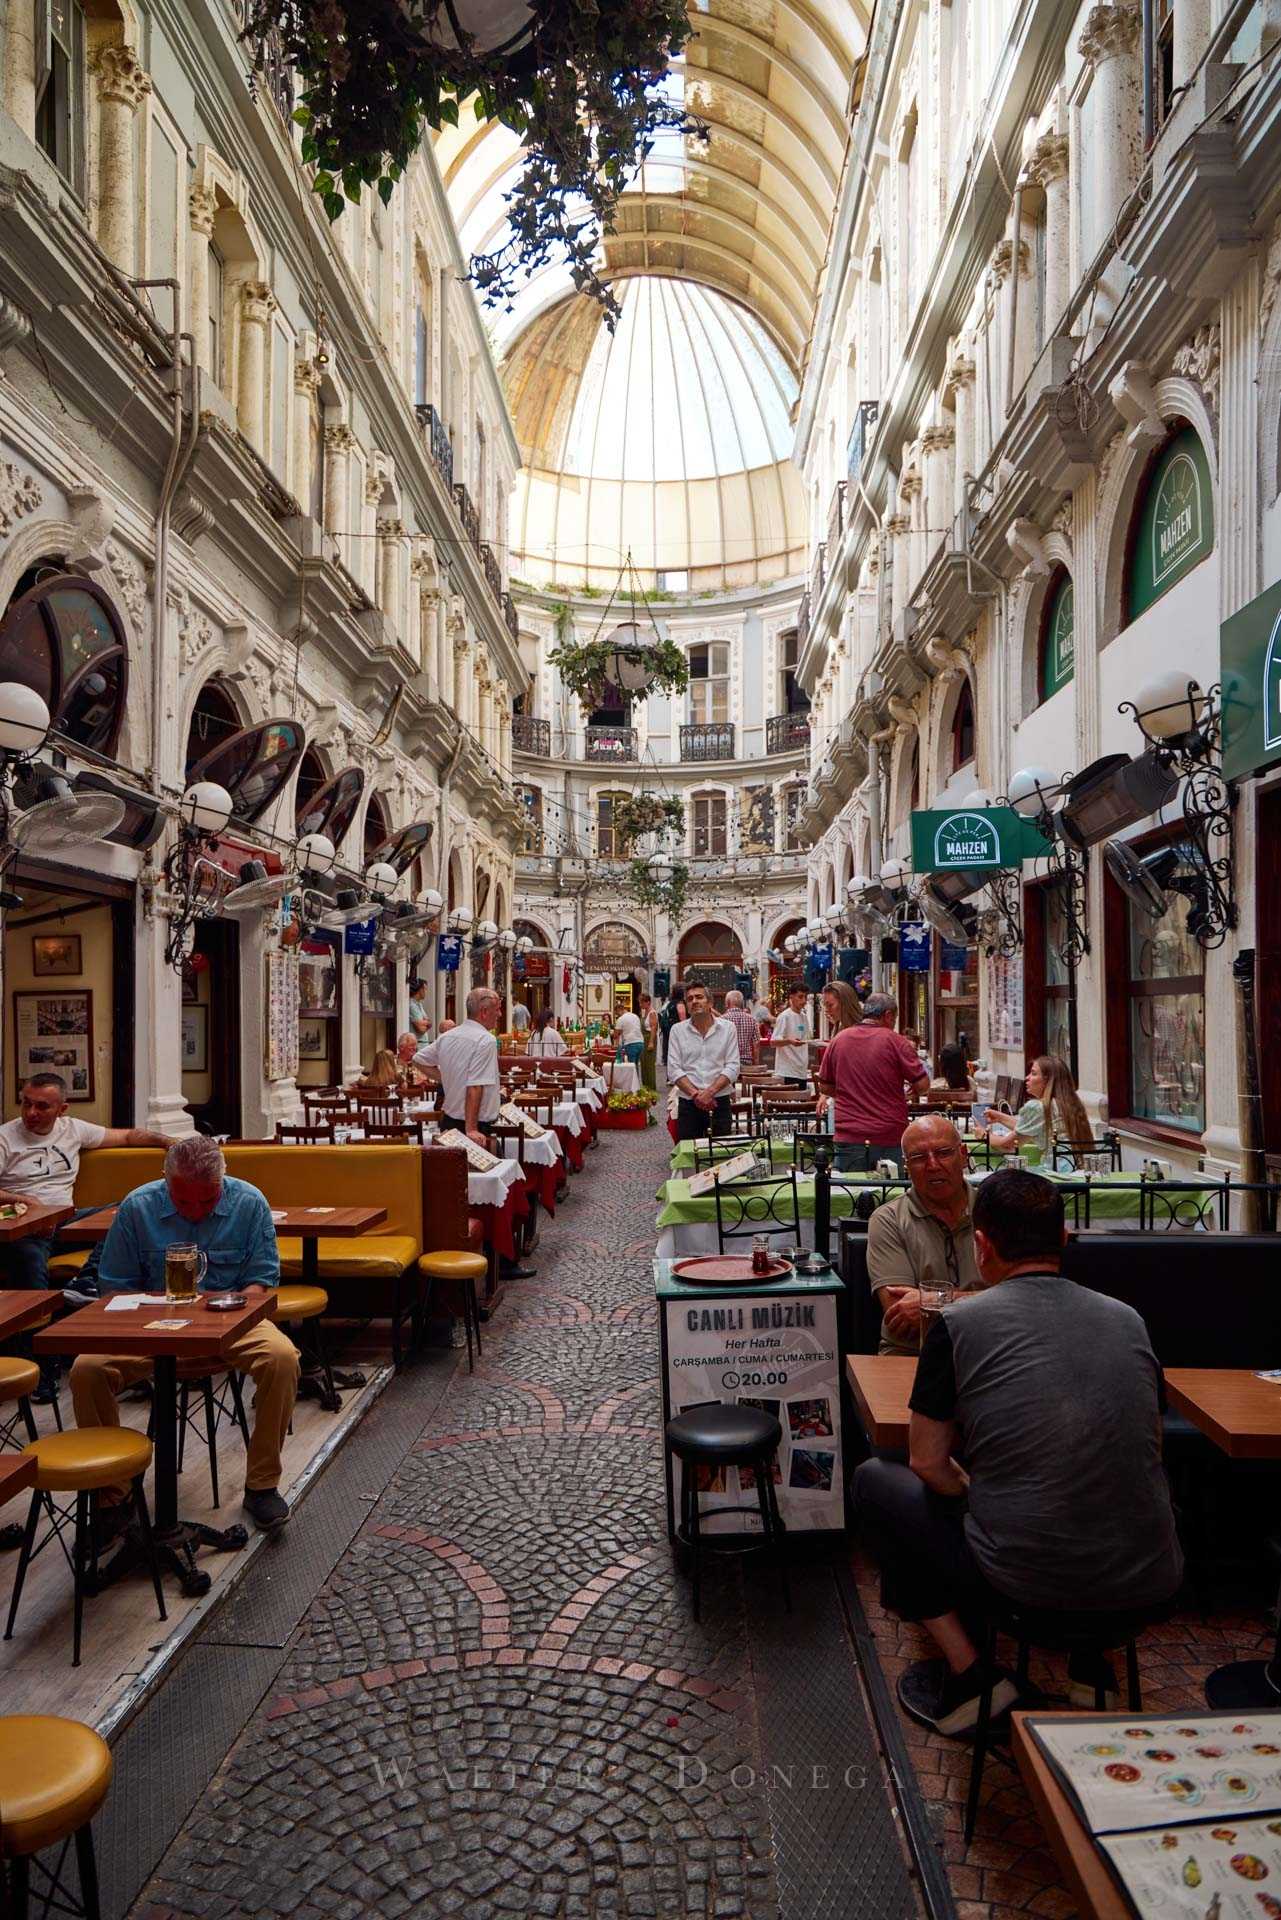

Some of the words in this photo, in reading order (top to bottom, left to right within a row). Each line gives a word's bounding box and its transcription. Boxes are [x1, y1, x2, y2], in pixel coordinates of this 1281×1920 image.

[1160, 504, 1192, 558] MAHZEN
[946, 841, 988, 855] MAHZEN
[687, 1308, 744, 1332] CANLI
[752, 1302, 815, 1329] MÜZİK
[725, 1339, 747, 1350] Her
[750, 1338, 781, 1349] Hafta
[673, 1356, 731, 1369] ÇARŞAMBA
[738, 1354, 768, 1365] CUMA
[776, 1351, 834, 1362] CUMARTESİ
[742, 1372, 788, 1386] 20.00
